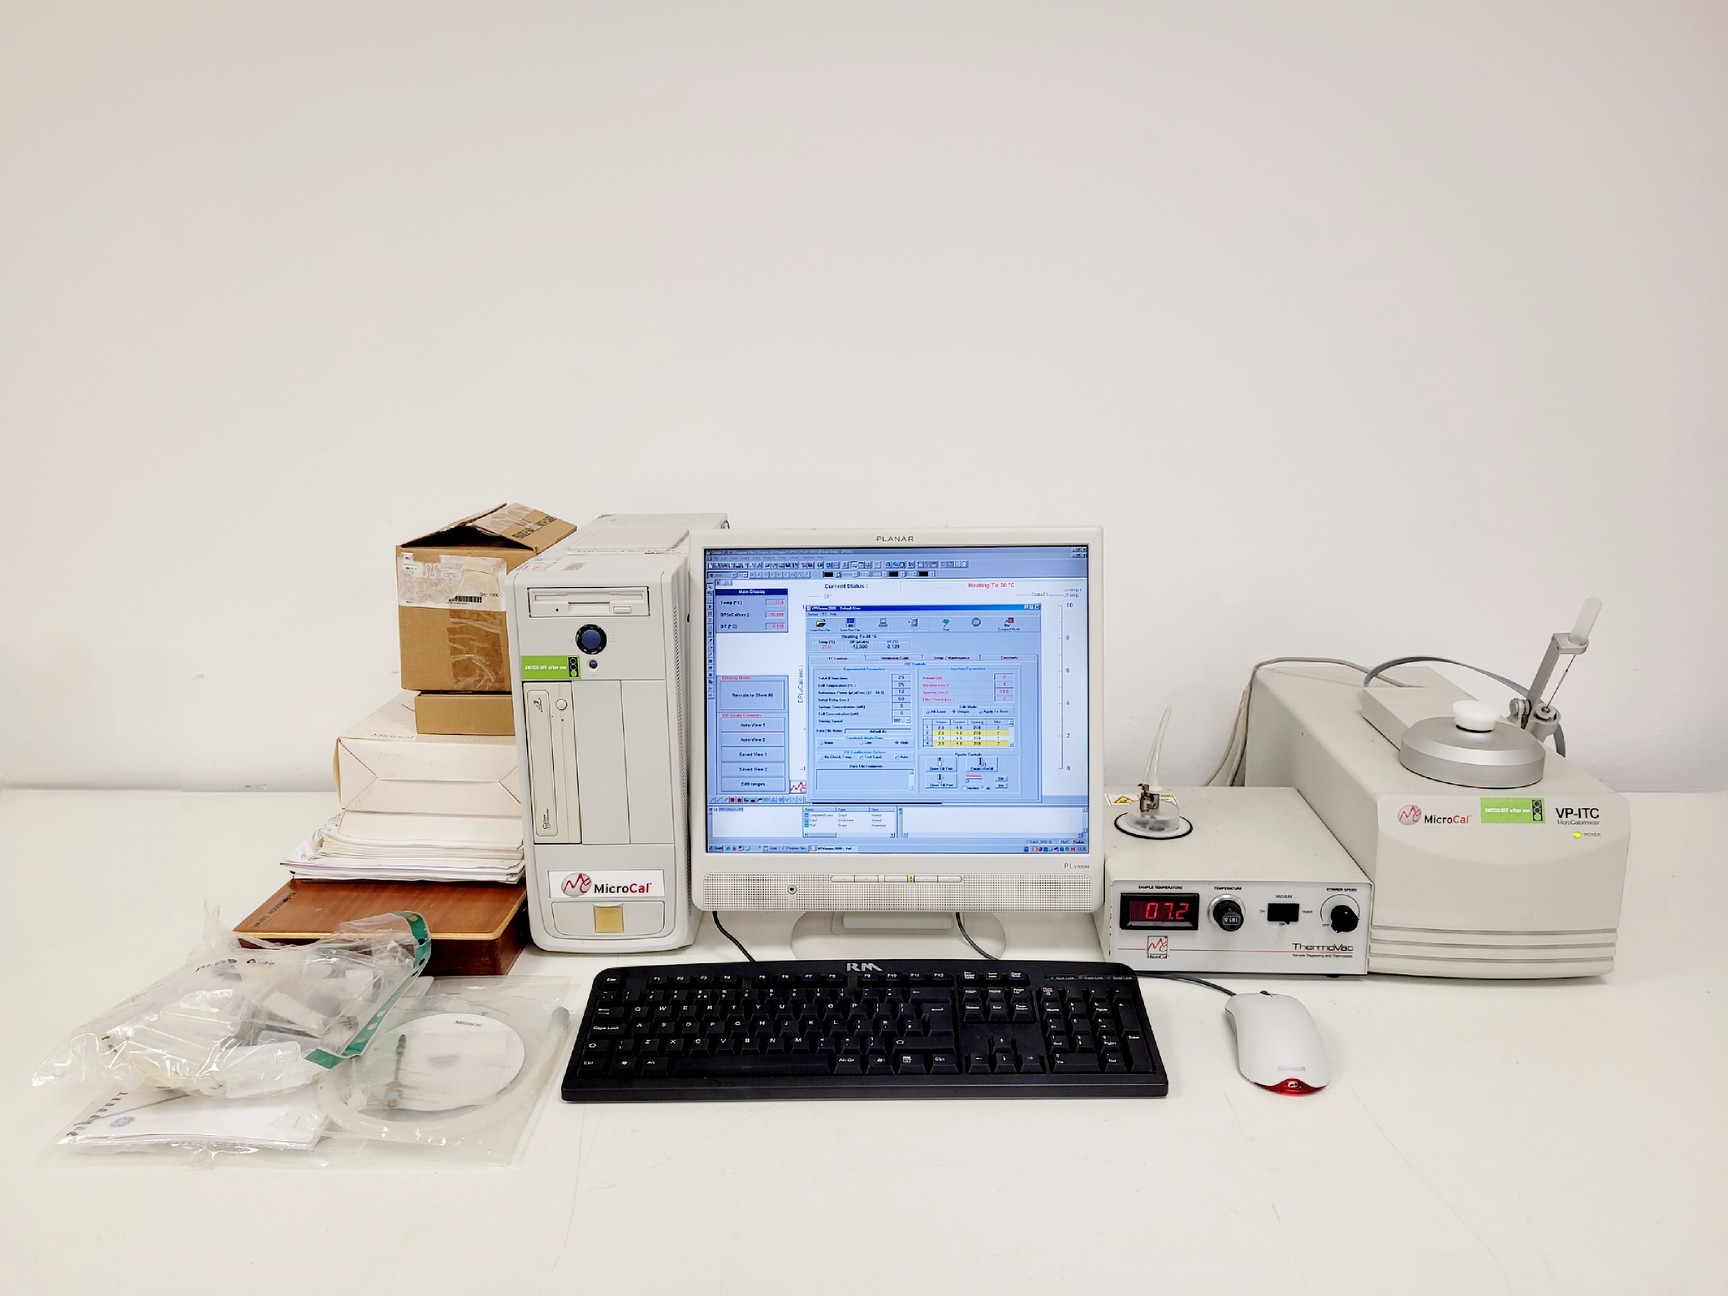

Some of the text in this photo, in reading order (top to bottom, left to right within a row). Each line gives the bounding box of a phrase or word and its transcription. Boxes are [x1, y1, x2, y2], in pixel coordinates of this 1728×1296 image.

[1555, 807, 1600, 819] VP-ITC
[1424, 814, 1469, 824] MicroCal
[594, 883, 650, 894] MicroCal
[1145, 902, 1189, 920] 07.2
[1292, 943, 1354, 952] ThermoVac
[846, 962, 883, 972] RM
